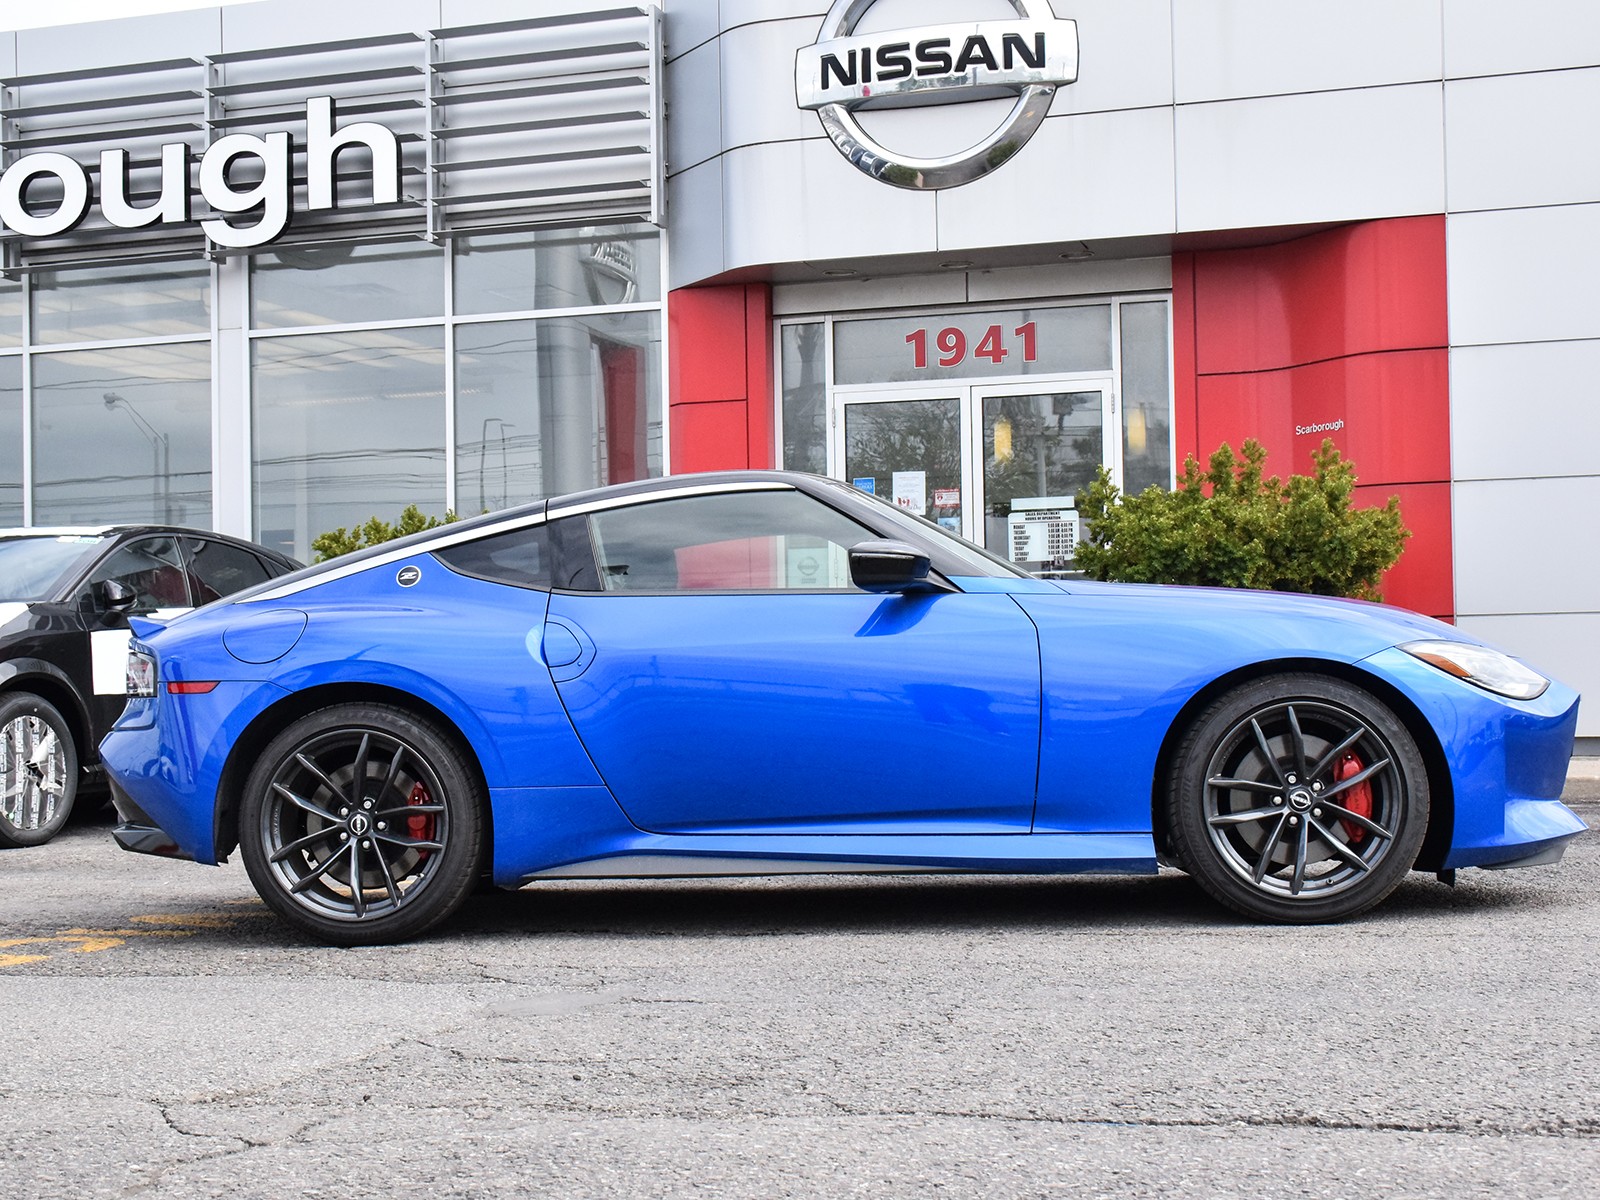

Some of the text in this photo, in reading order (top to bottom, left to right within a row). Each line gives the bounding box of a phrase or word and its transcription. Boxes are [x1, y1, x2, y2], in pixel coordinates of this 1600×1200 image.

[821, 32, 1046, 90] NISSAN
[0, 95, 399, 248] ough
[905, 321, 1037, 369] 1941
[1295, 418, 1344, 435] Scarborough
